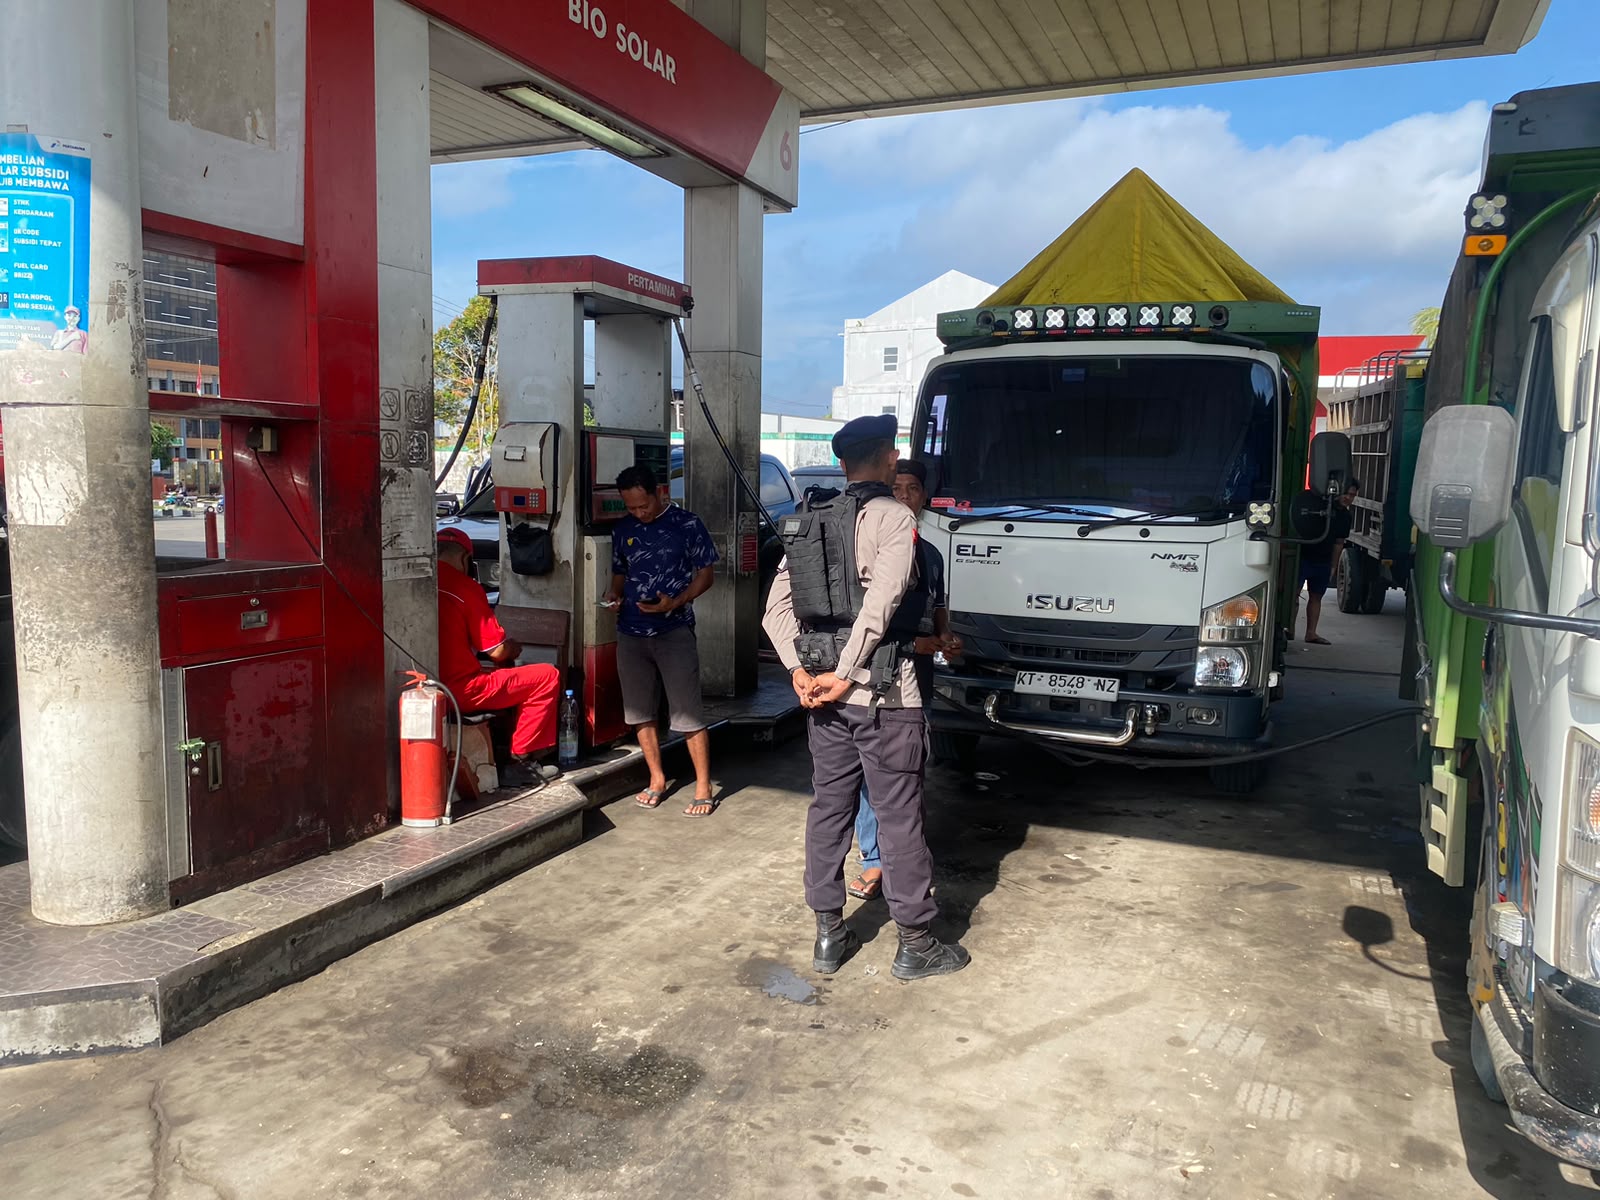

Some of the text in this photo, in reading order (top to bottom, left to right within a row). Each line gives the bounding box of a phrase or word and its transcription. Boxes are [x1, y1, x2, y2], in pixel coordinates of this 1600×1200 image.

[568, 0, 677, 85] BIO SOLAR
[780, 130, 792, 171] 6
[0, 154, 45, 166] MBELIAN
[21, 165, 69, 180] SUBSIDI
[16, 177, 69, 191] MEMBAWA
[13, 208, 54, 218] KENDARAAN
[13, 237, 62, 248] SUBSIDI TEPAT
[30, 263, 49, 271] CARD
[628, 272, 676, 299] PERTAMINA
[30, 293, 53, 302] NOPOL
[31, 303, 55, 311] SESUAI
[956, 544, 1002, 558] ELF
[1150, 553, 1200, 561] NMR
[1026, 593, 1115, 613] ISUZU
[1017, 672, 1117, 693] KT 8548 NZ
